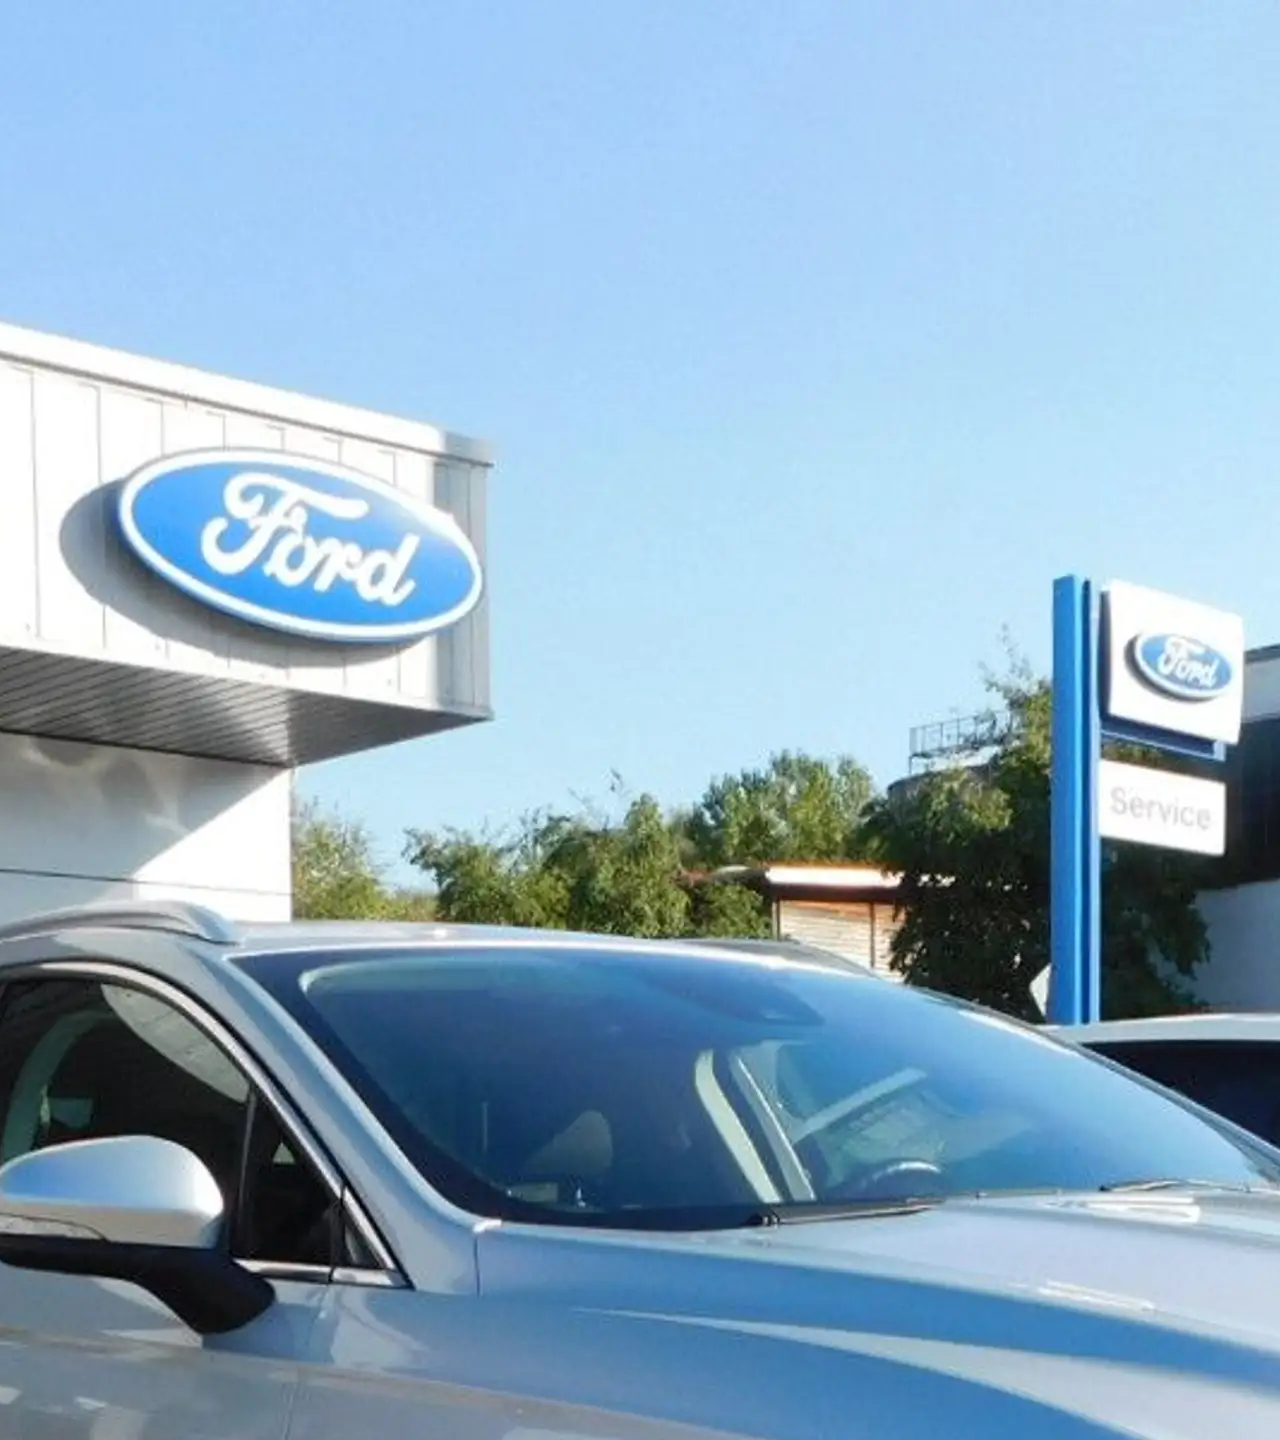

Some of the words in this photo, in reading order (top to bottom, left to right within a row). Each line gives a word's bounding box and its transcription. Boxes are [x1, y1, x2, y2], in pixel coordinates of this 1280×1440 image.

[200, 472, 420, 607] Ford
[1157, 637, 1219, 688] Ford
[1110, 786, 1212, 830] Service
